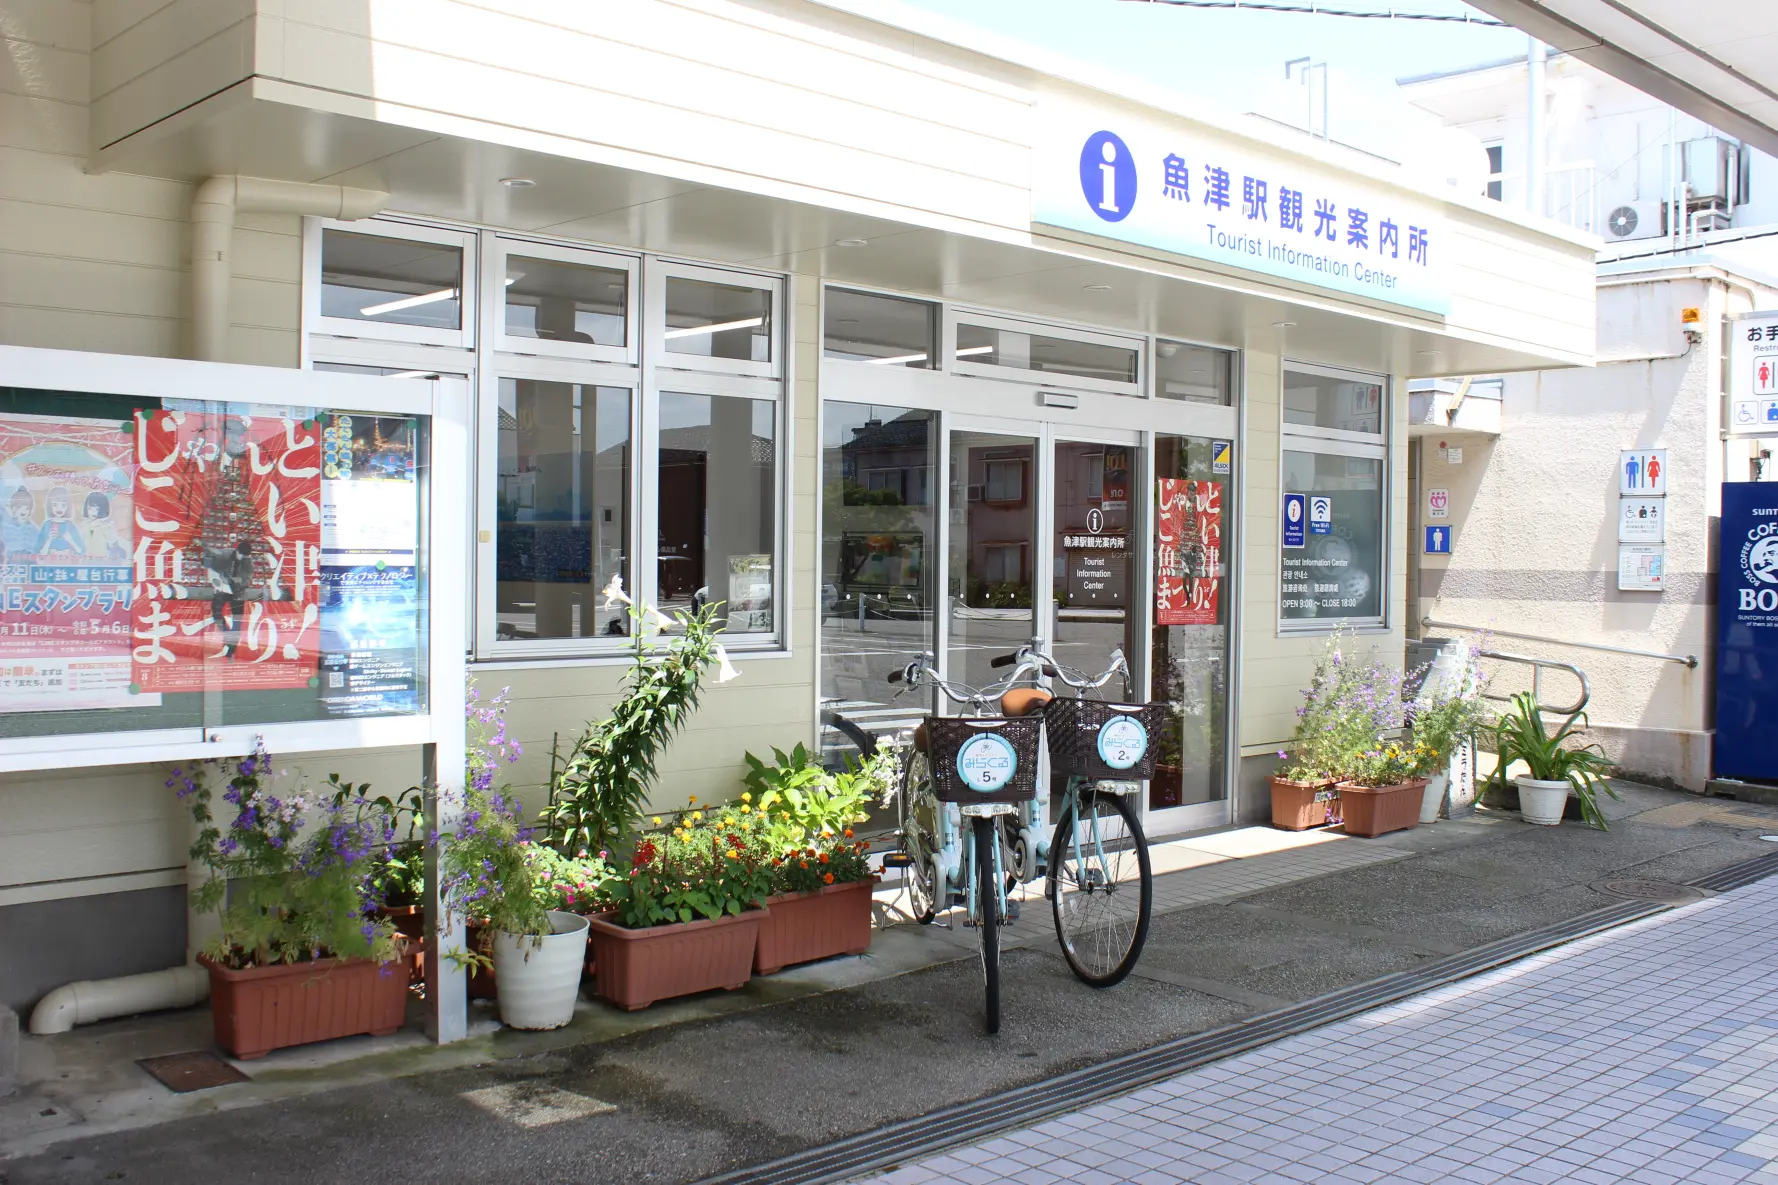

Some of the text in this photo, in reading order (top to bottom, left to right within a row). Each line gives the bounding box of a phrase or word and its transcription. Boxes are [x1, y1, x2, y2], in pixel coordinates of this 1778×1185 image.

[1162, 153, 1429, 266] 魚津駅観光案内所
[1207, 224, 1397, 289] Tourist Information Center
[1748, 522, 1778, 541] COF
[1064, 535, 1125, 549] 魚津駅観光案内所
[1084, 557, 1105, 566] Tourist
[1158, 543, 1219, 578] 魚津
[1283, 558, 1348, 567] Tourist Information Center
[1740, 541, 1761, 587] BOSS COFFEE
[133, 535, 321, 601] 魚津
[1077, 569, 1111, 578] Information
[1083, 581, 1105, 590] Center
[1282, 600, 1299, 608] OPEN
[1300, 599, 1313, 608] 9:00
[1321, 599, 1341, 607] CLOSE
[1341, 598, 1357, 607] 18:00
[965, 757, 1008, 769] みらくる
